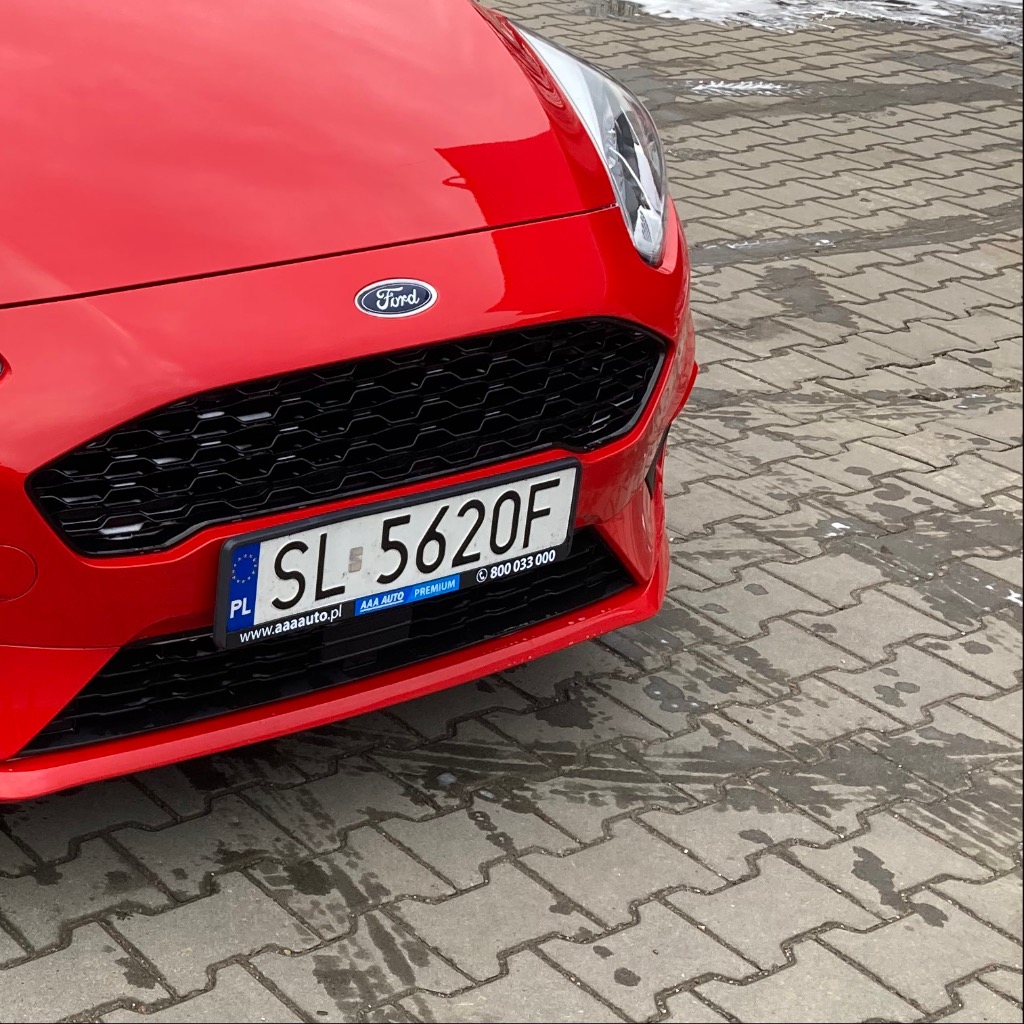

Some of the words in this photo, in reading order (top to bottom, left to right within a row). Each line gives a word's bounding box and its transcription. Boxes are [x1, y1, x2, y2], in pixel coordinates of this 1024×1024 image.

[376, 286, 420, 311] Ford
[271, 533, 346, 610] SL
[376, 478, 561, 585] 5620F
[490, 566, 512, 579] 800
[513, 558, 534, 573] 033
[535, 549, 556, 566] 000
[229, 597, 252, 619] PL
[360, 597, 379, 611] AAA
[381, 591, 405, 606] AUTO
[414, 579, 456, 598] PREMIUM
[239, 604, 343, 643] www.aaaauto.pl
